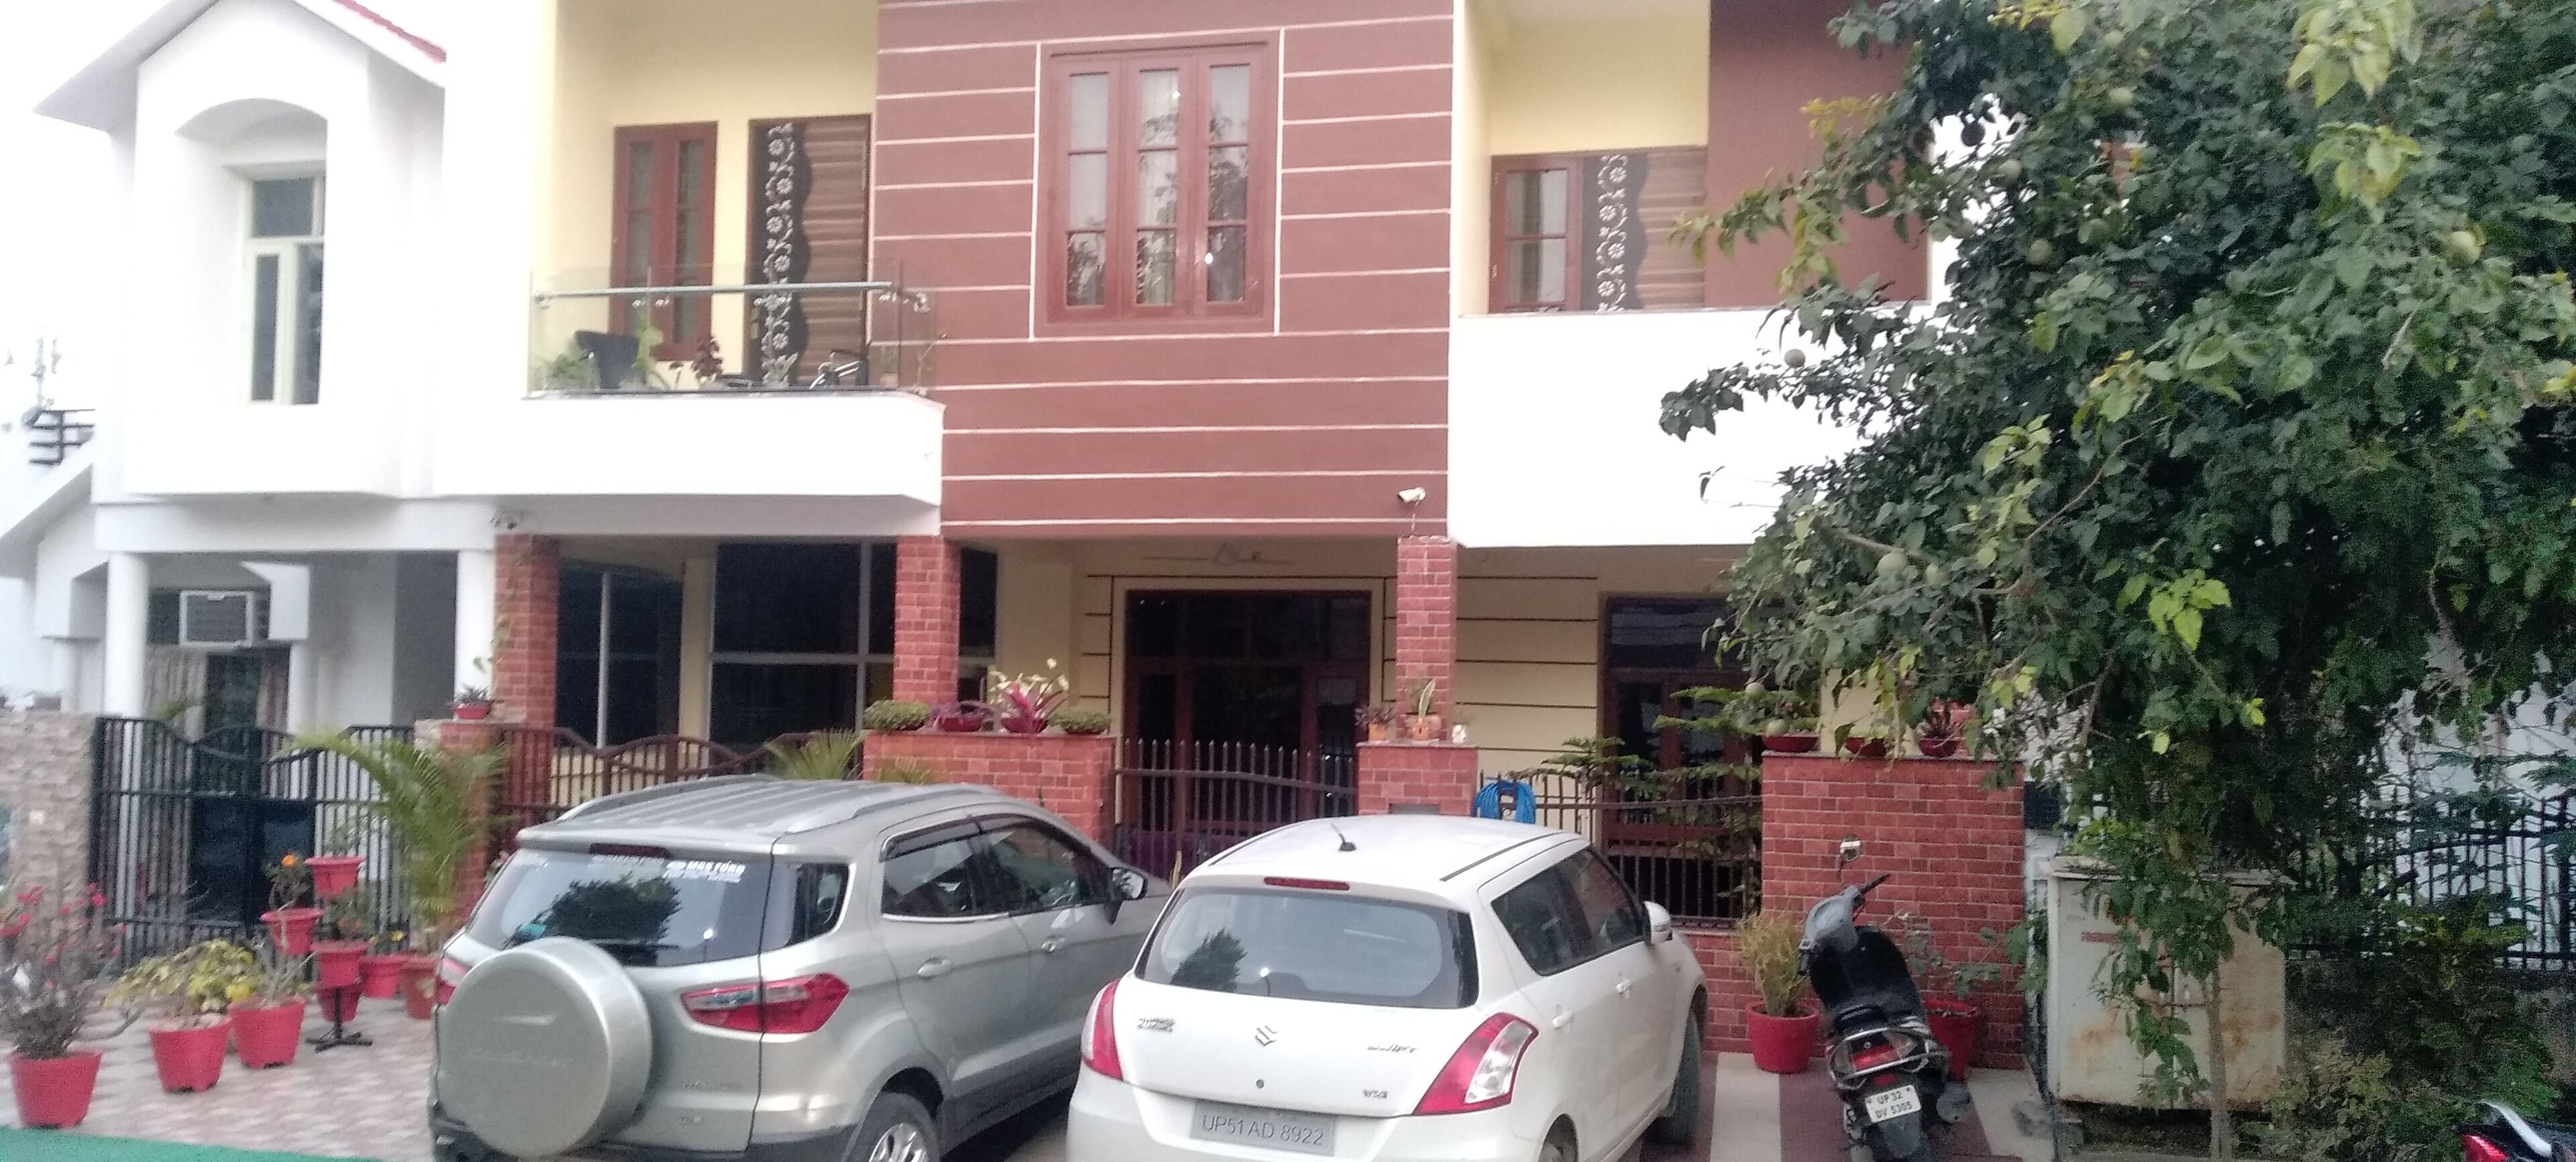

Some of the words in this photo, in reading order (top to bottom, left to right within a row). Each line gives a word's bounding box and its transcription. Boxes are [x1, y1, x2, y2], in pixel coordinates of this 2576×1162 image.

[1878, 1094, 1889, 1105] UP
[1891, 1090, 1903, 1101] 32
[1248, 1119, 1275, 1139] AD
[1280, 1124, 1324, 1145] 8922
